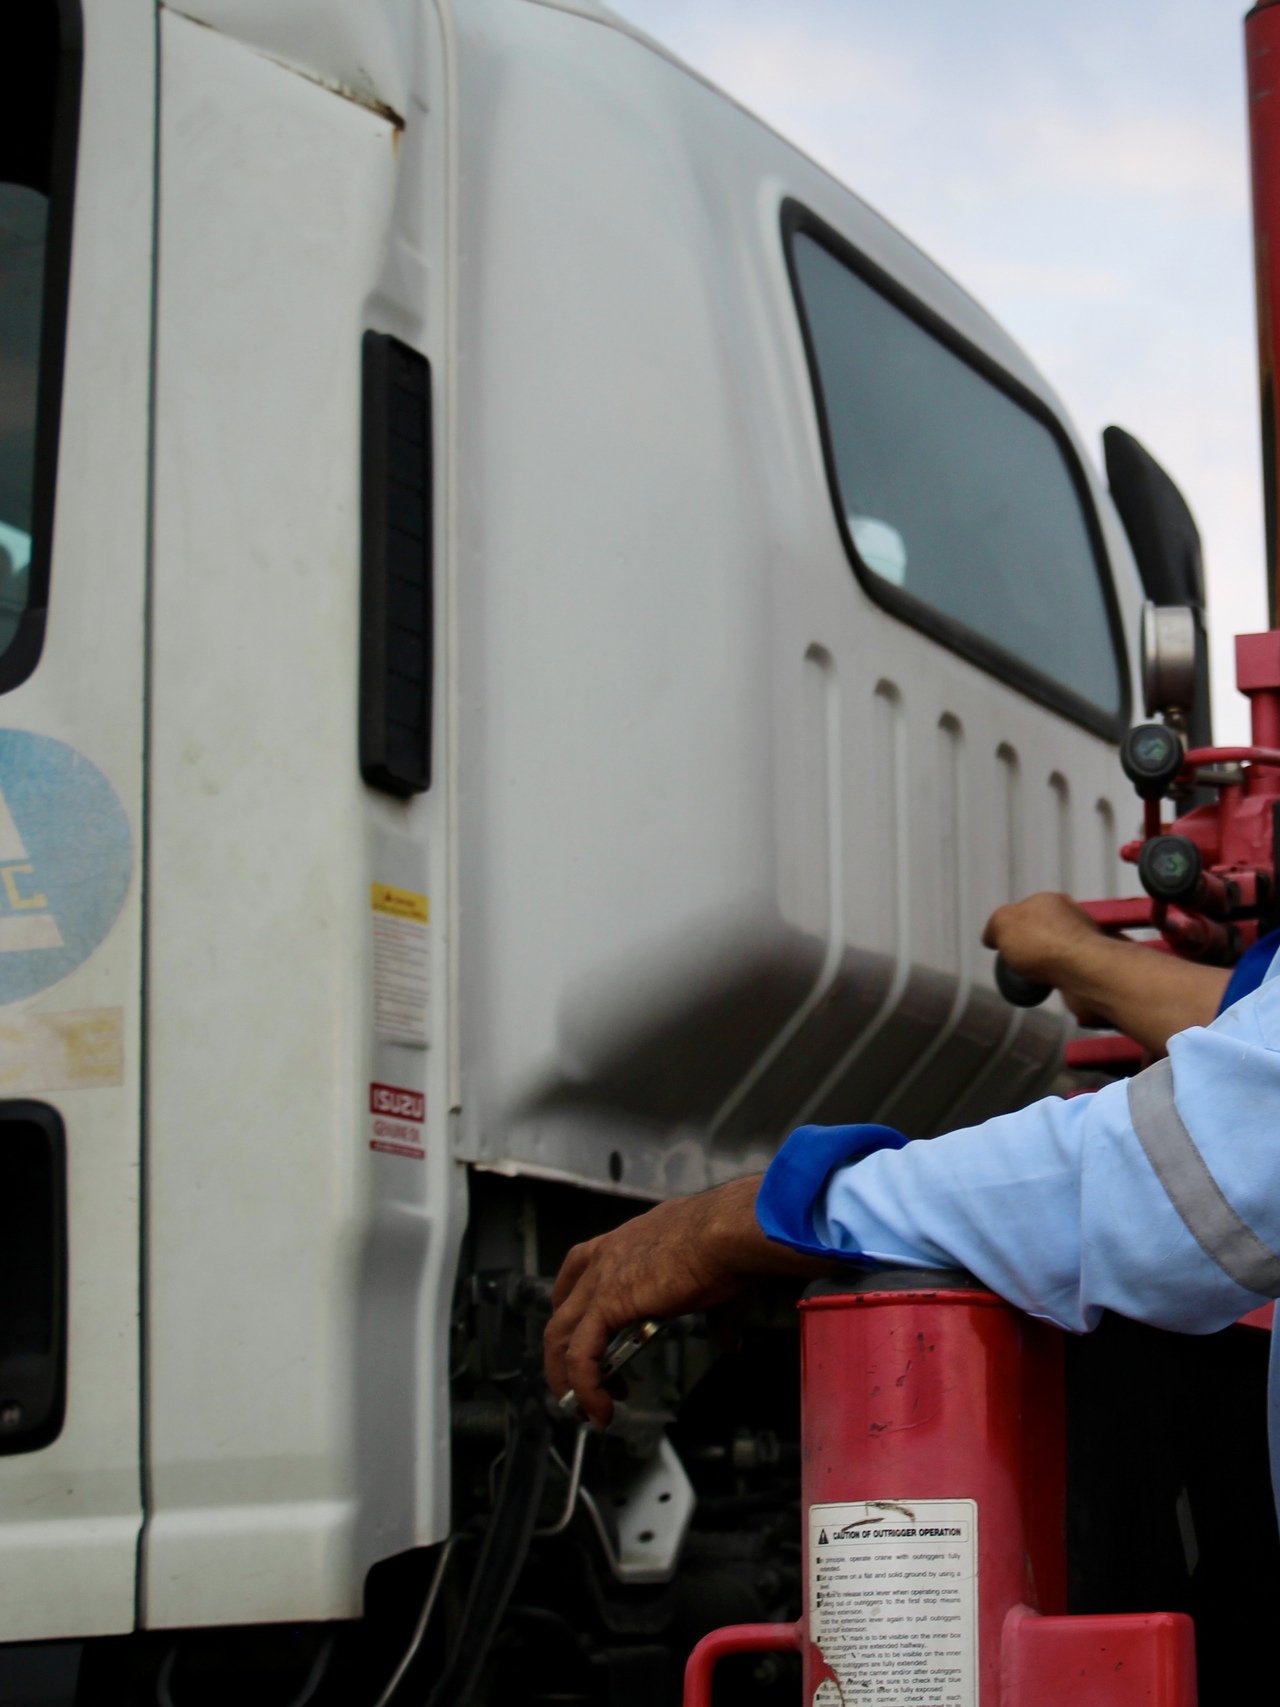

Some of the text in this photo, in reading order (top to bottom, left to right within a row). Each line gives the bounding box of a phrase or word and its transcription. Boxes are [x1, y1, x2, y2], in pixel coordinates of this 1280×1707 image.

[373, 1089, 424, 1118] ISUZU
[833, 1528, 961, 1540] CAUTION OF OUTRIGGER OPERATION
[911, 1588, 940, 1596] operating
[853, 1599, 883, 1607] outriggers
[901, 1686, 914, 1694] fully
